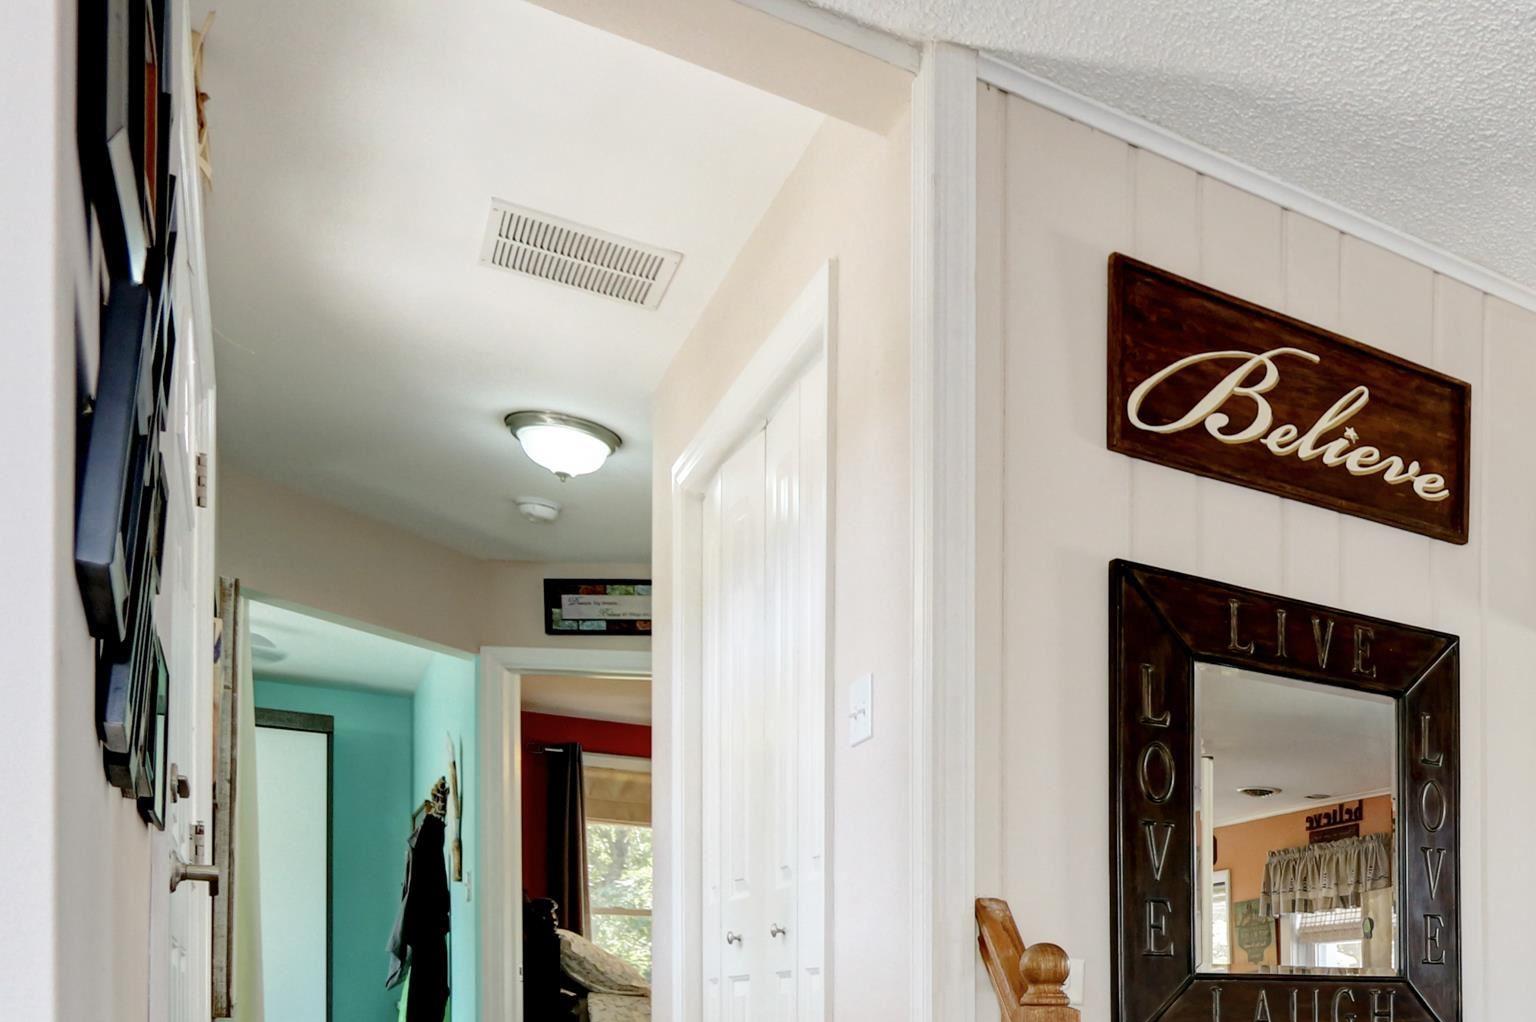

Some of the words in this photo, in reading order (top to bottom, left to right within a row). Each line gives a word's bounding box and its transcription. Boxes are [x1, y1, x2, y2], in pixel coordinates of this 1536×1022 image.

[1126, 347, 1450, 501] Believe
[1226, 598, 1378, 679] LIVE
[1136, 663, 1176, 958] LOVE
[1418, 711, 1446, 966] LOVE
